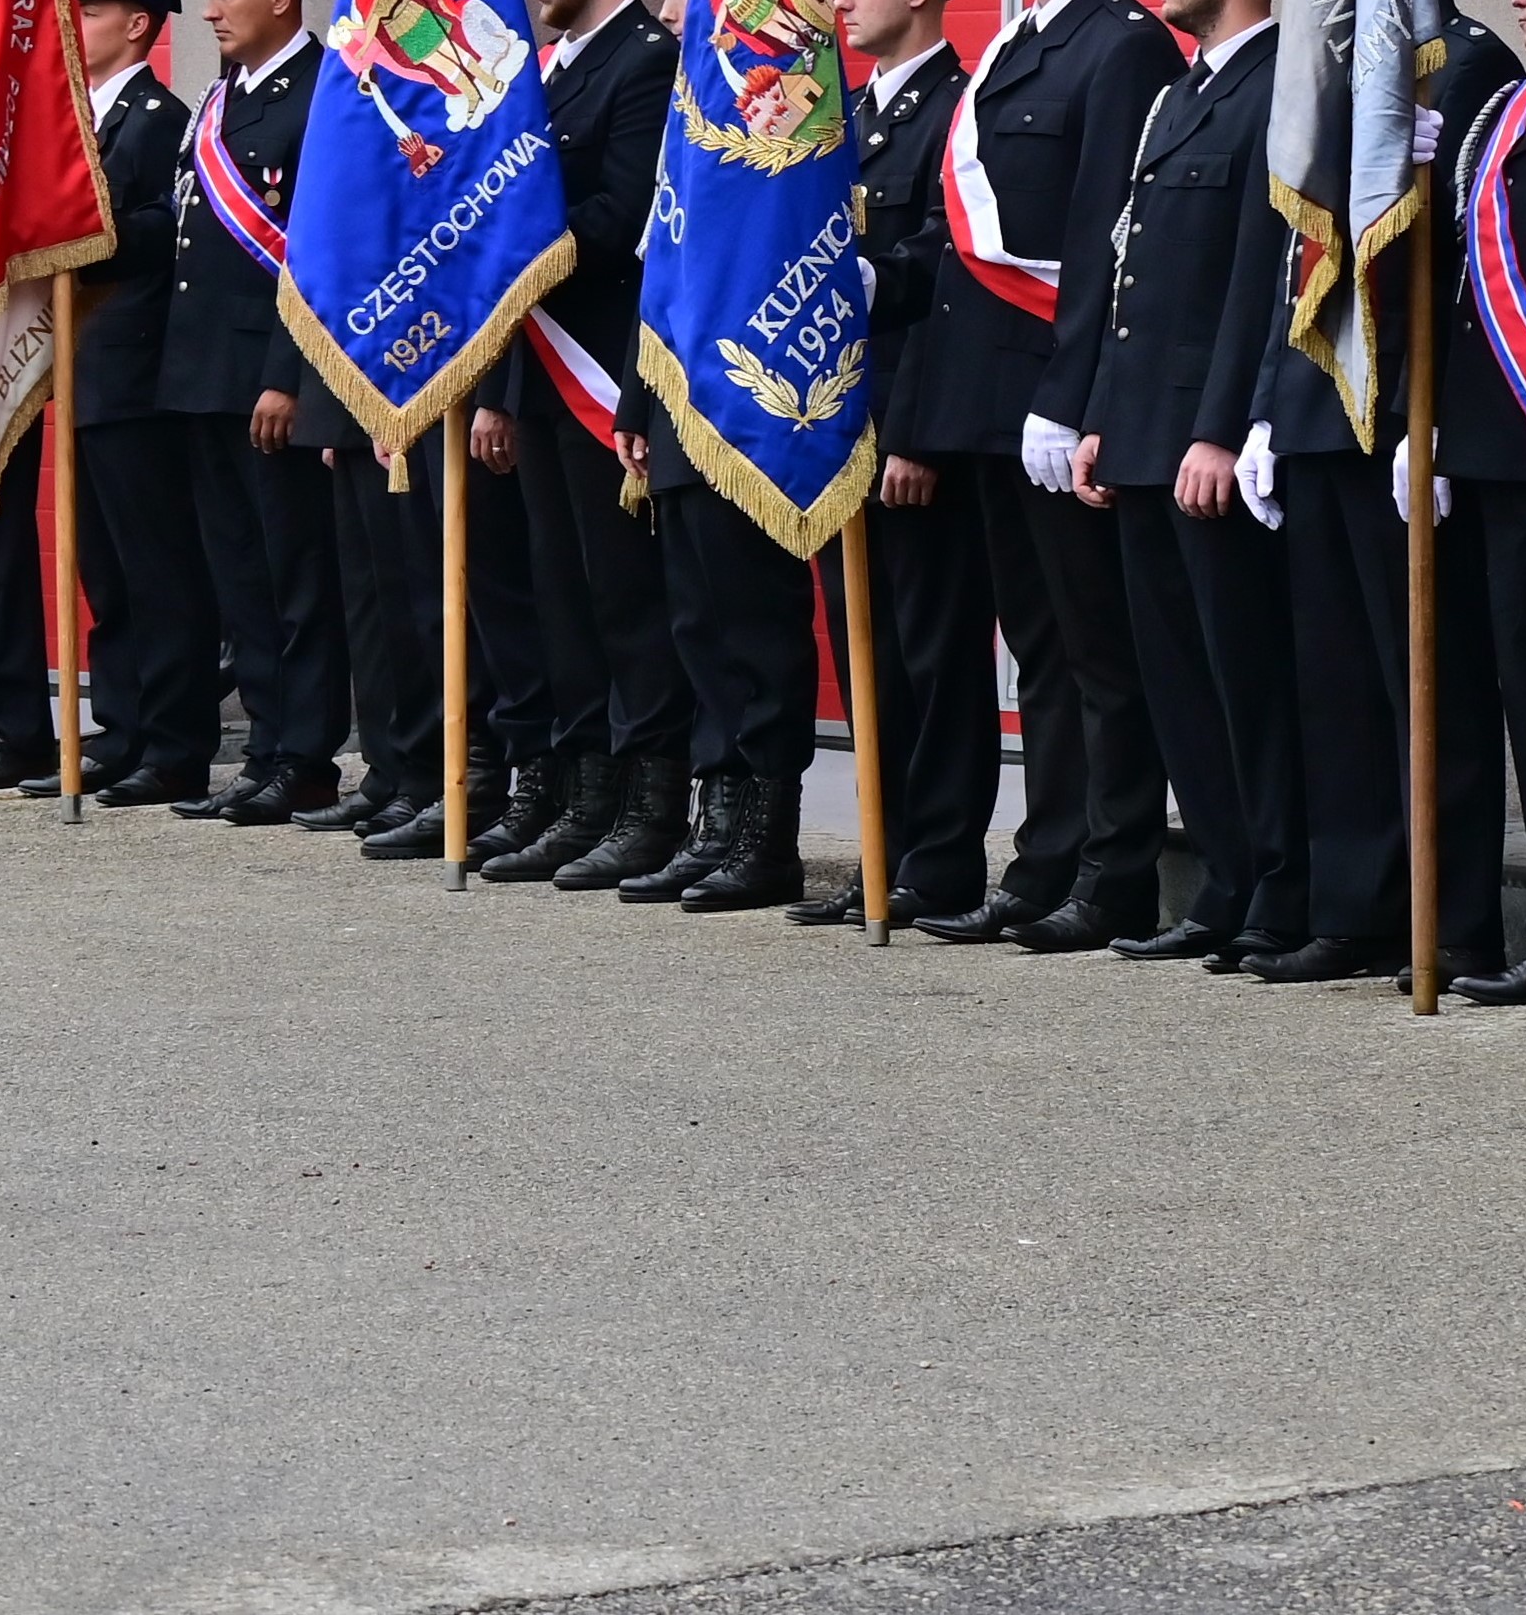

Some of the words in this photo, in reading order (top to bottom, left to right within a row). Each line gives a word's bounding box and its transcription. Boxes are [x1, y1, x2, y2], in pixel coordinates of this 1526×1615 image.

[347, 131, 551, 335] CZĘSTOCHOWA
[383, 310, 453, 373] 1922
[785, 287, 854, 377] 1954
